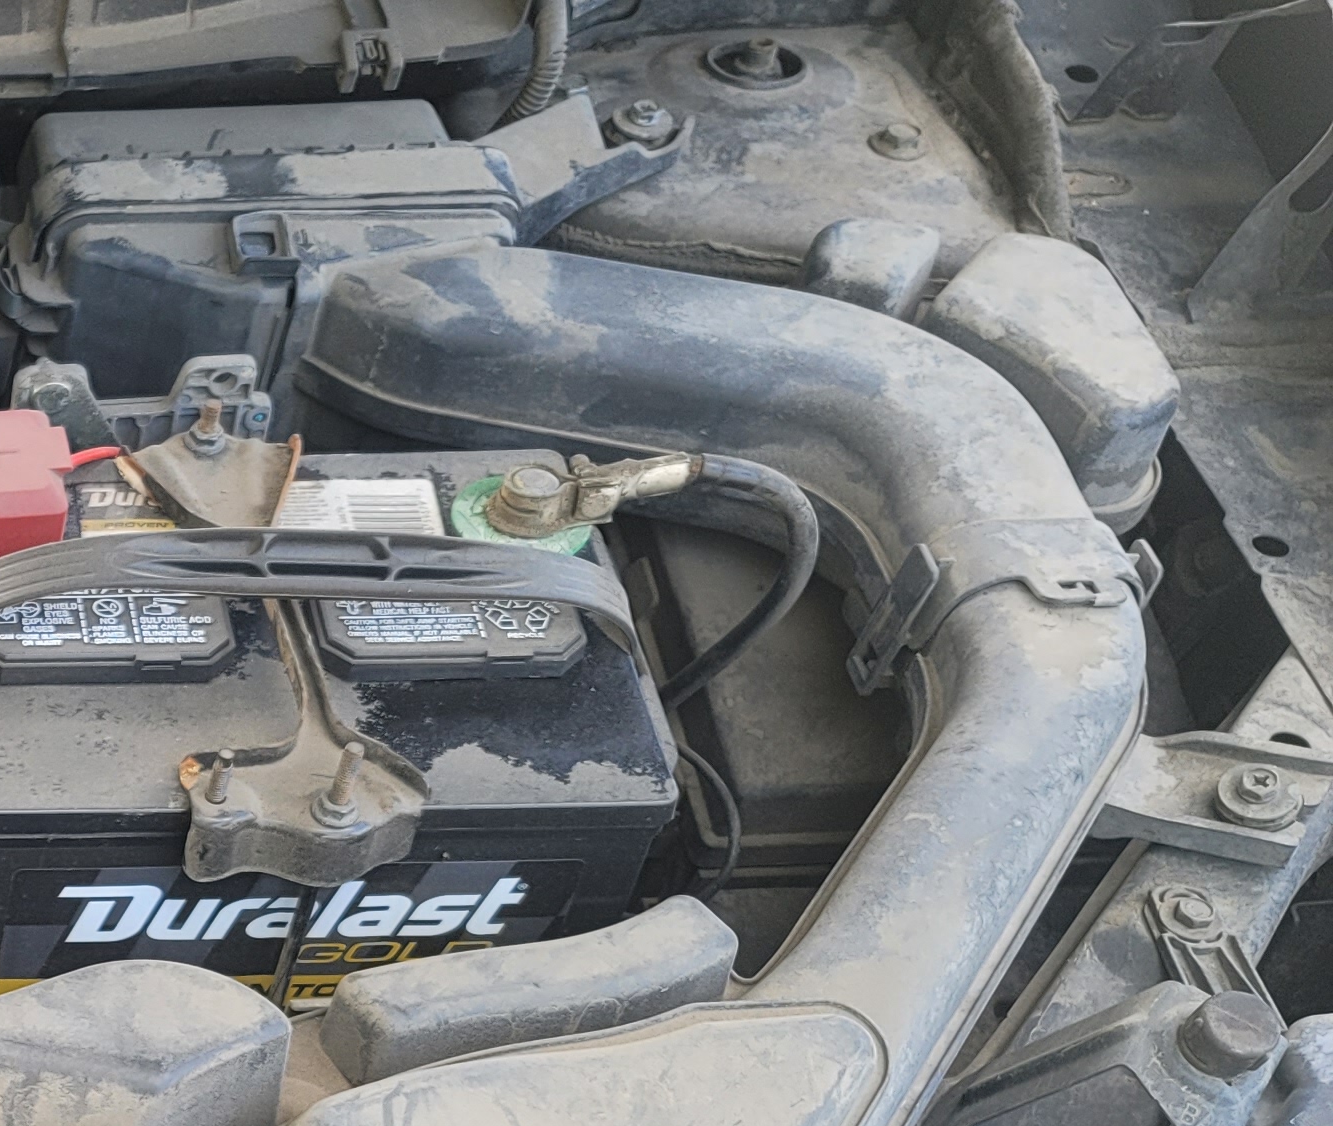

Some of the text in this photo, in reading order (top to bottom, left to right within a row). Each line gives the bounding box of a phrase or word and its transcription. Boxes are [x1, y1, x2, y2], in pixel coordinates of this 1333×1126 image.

[43, 602, 78, 611] SHIELD
[44, 610, 70, 618] EYES
[372, 607, 408, 615] MEDICAL
[21, 617, 75, 625] EXPLOSIVE
[99, 617, 116, 625] NO
[139, 616, 213, 624] SULFURIC ACID
[22, 625, 56, 633] GASES
[507, 631, 547, 640] RECYCLE
[57, 876, 526, 944] Duralast
